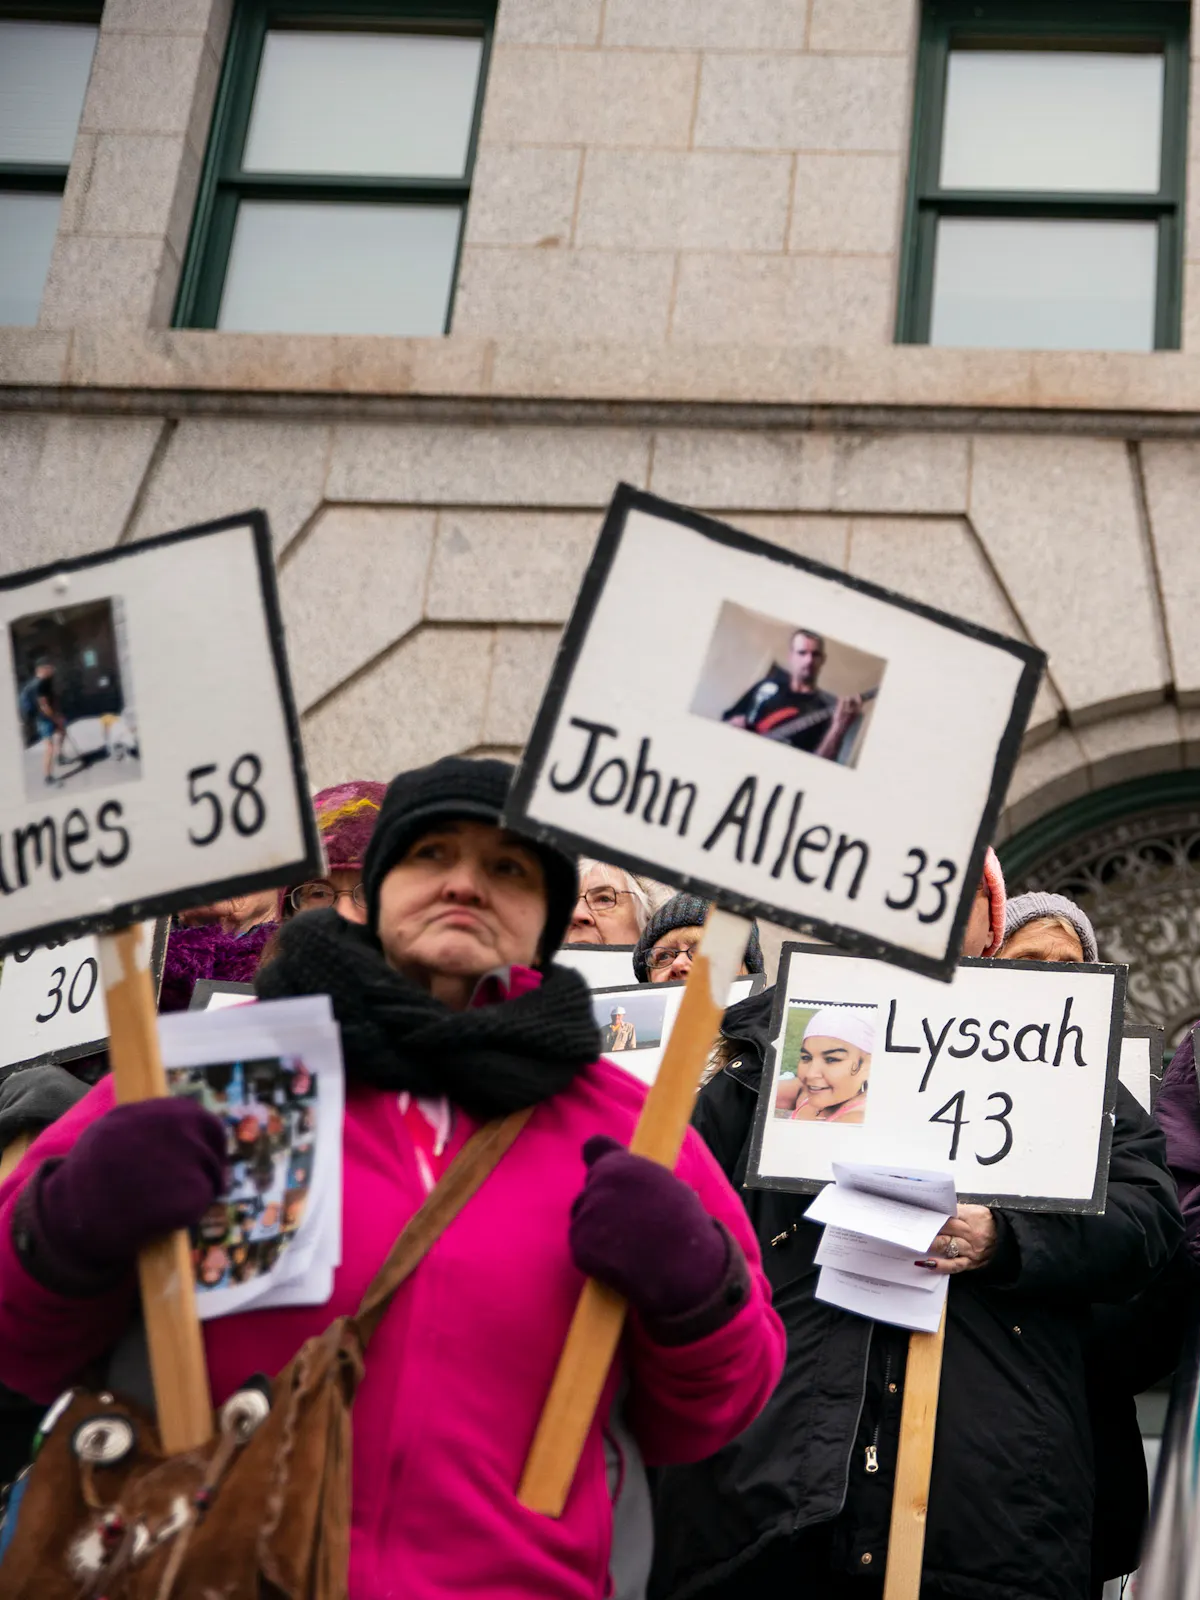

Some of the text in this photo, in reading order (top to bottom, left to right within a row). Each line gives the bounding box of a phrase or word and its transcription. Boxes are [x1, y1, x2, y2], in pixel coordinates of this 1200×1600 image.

[0, 752, 267, 896] mes 58
[548, 716, 959, 924] John Allen 33
[35, 956, 98, 1024] 30
[883, 995, 1088, 1092] Lyssah
[928, 1090, 1014, 1166] 43
